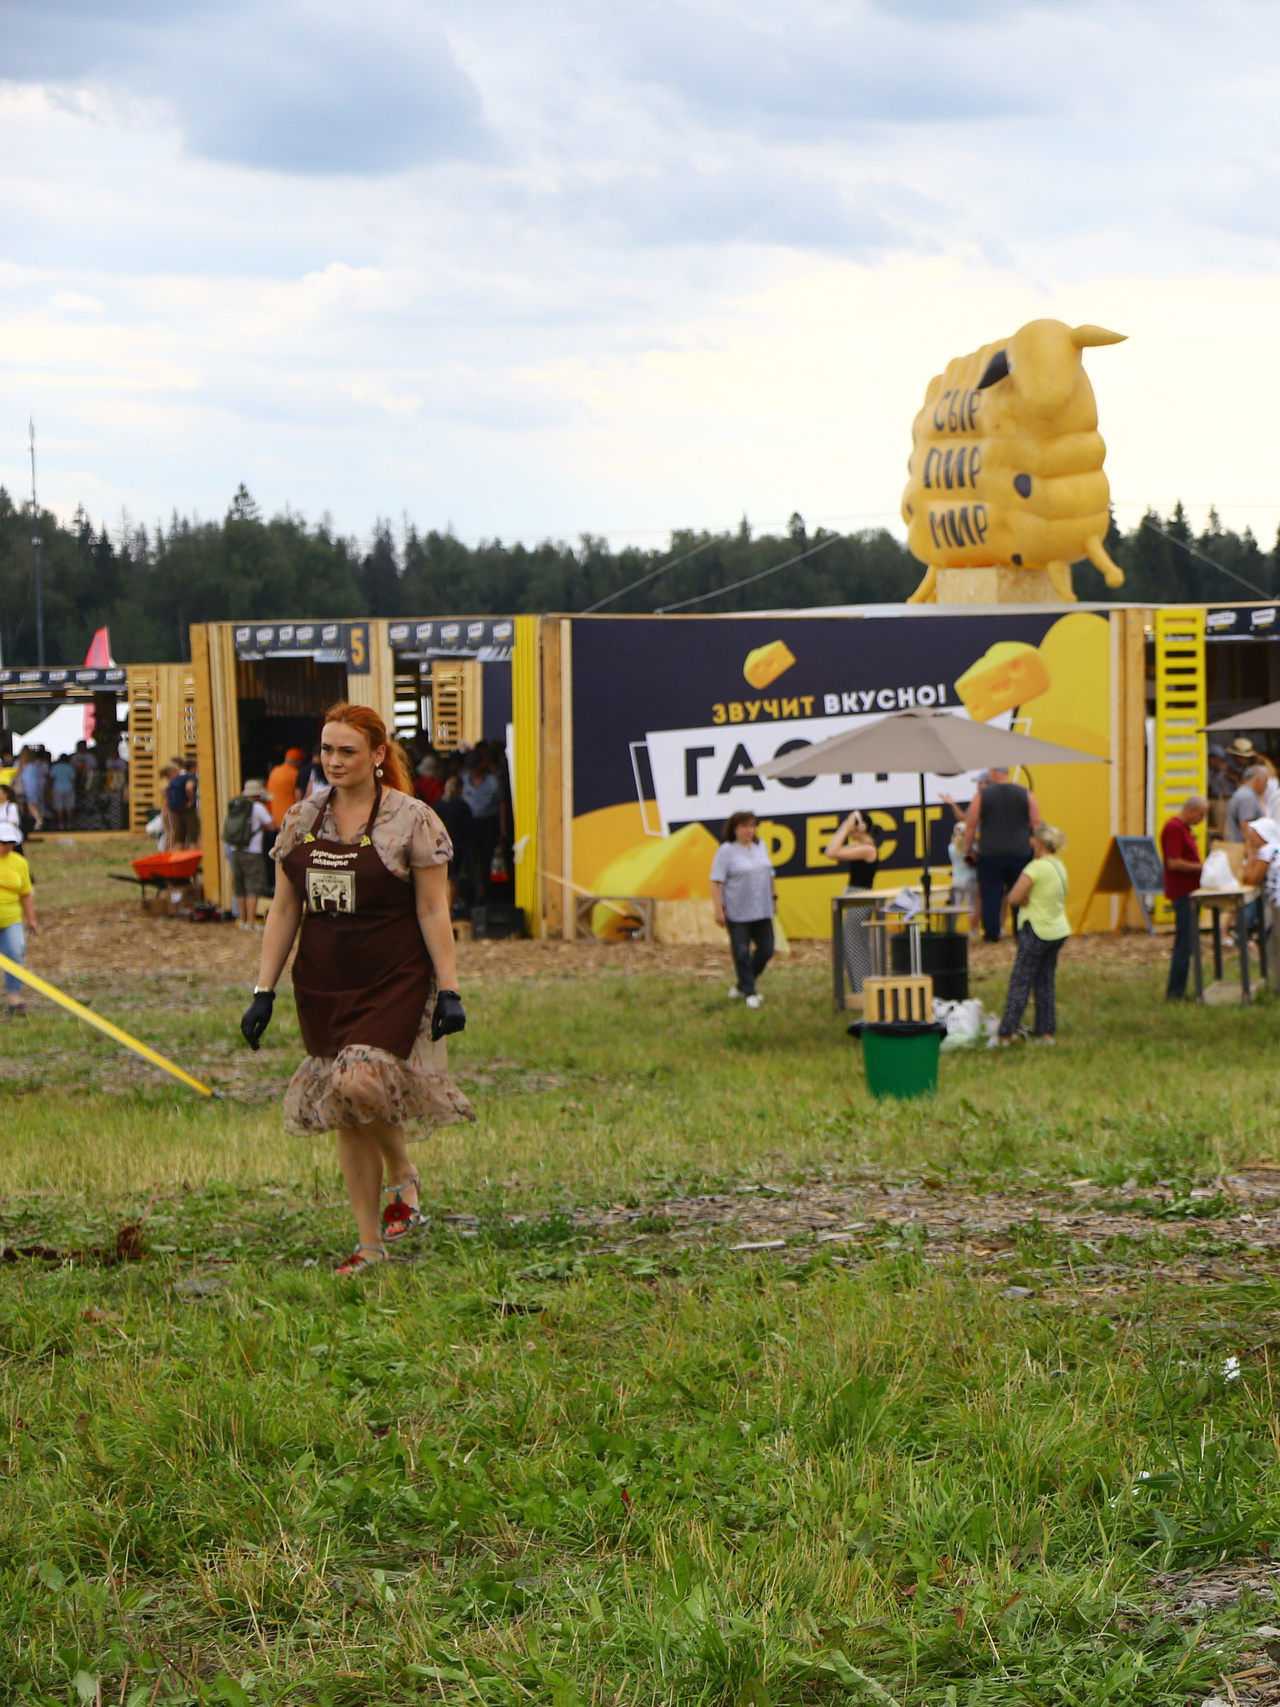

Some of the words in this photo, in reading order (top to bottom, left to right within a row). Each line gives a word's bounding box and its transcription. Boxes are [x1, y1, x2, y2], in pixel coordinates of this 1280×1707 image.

[933, 388, 982, 432] СЫР
[923, 446, 981, 490] ПИР
[929, 504, 988, 549] МИР
[351, 628, 365, 666] 5
[712, 695, 815, 724] ЗВУЧИТ
[823, 684, 946, 715] ВКУСНО!
